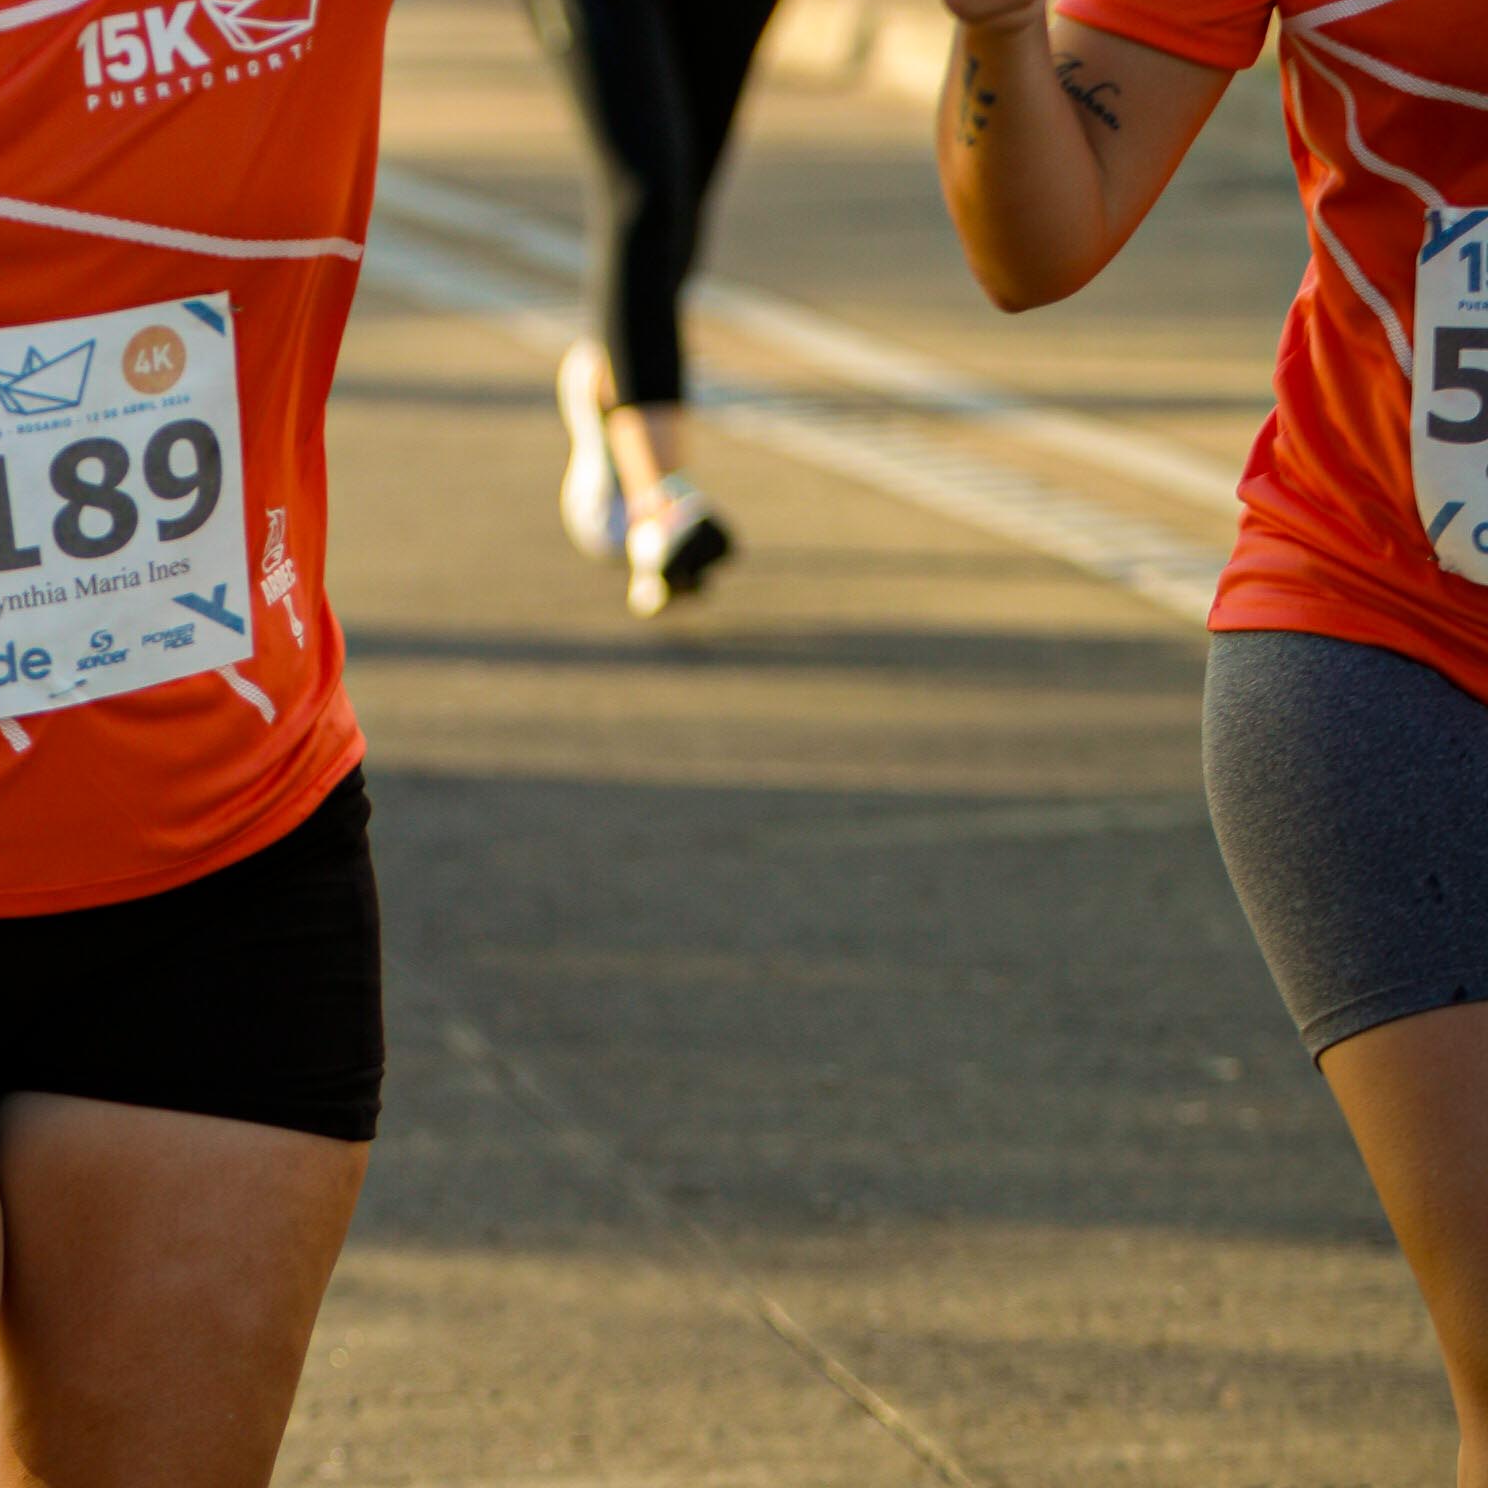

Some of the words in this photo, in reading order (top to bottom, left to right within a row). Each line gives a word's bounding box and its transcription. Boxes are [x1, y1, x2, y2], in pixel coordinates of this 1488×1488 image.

[77, 0, 211, 87] 15K
[86, 71, 213, 112] PUERTO
[133, 343, 173, 374] 4K
[16, 417, 72, 434] ROSARIO
[74, 566, 141, 599] Maria
[148, 557, 191, 583] Ines
